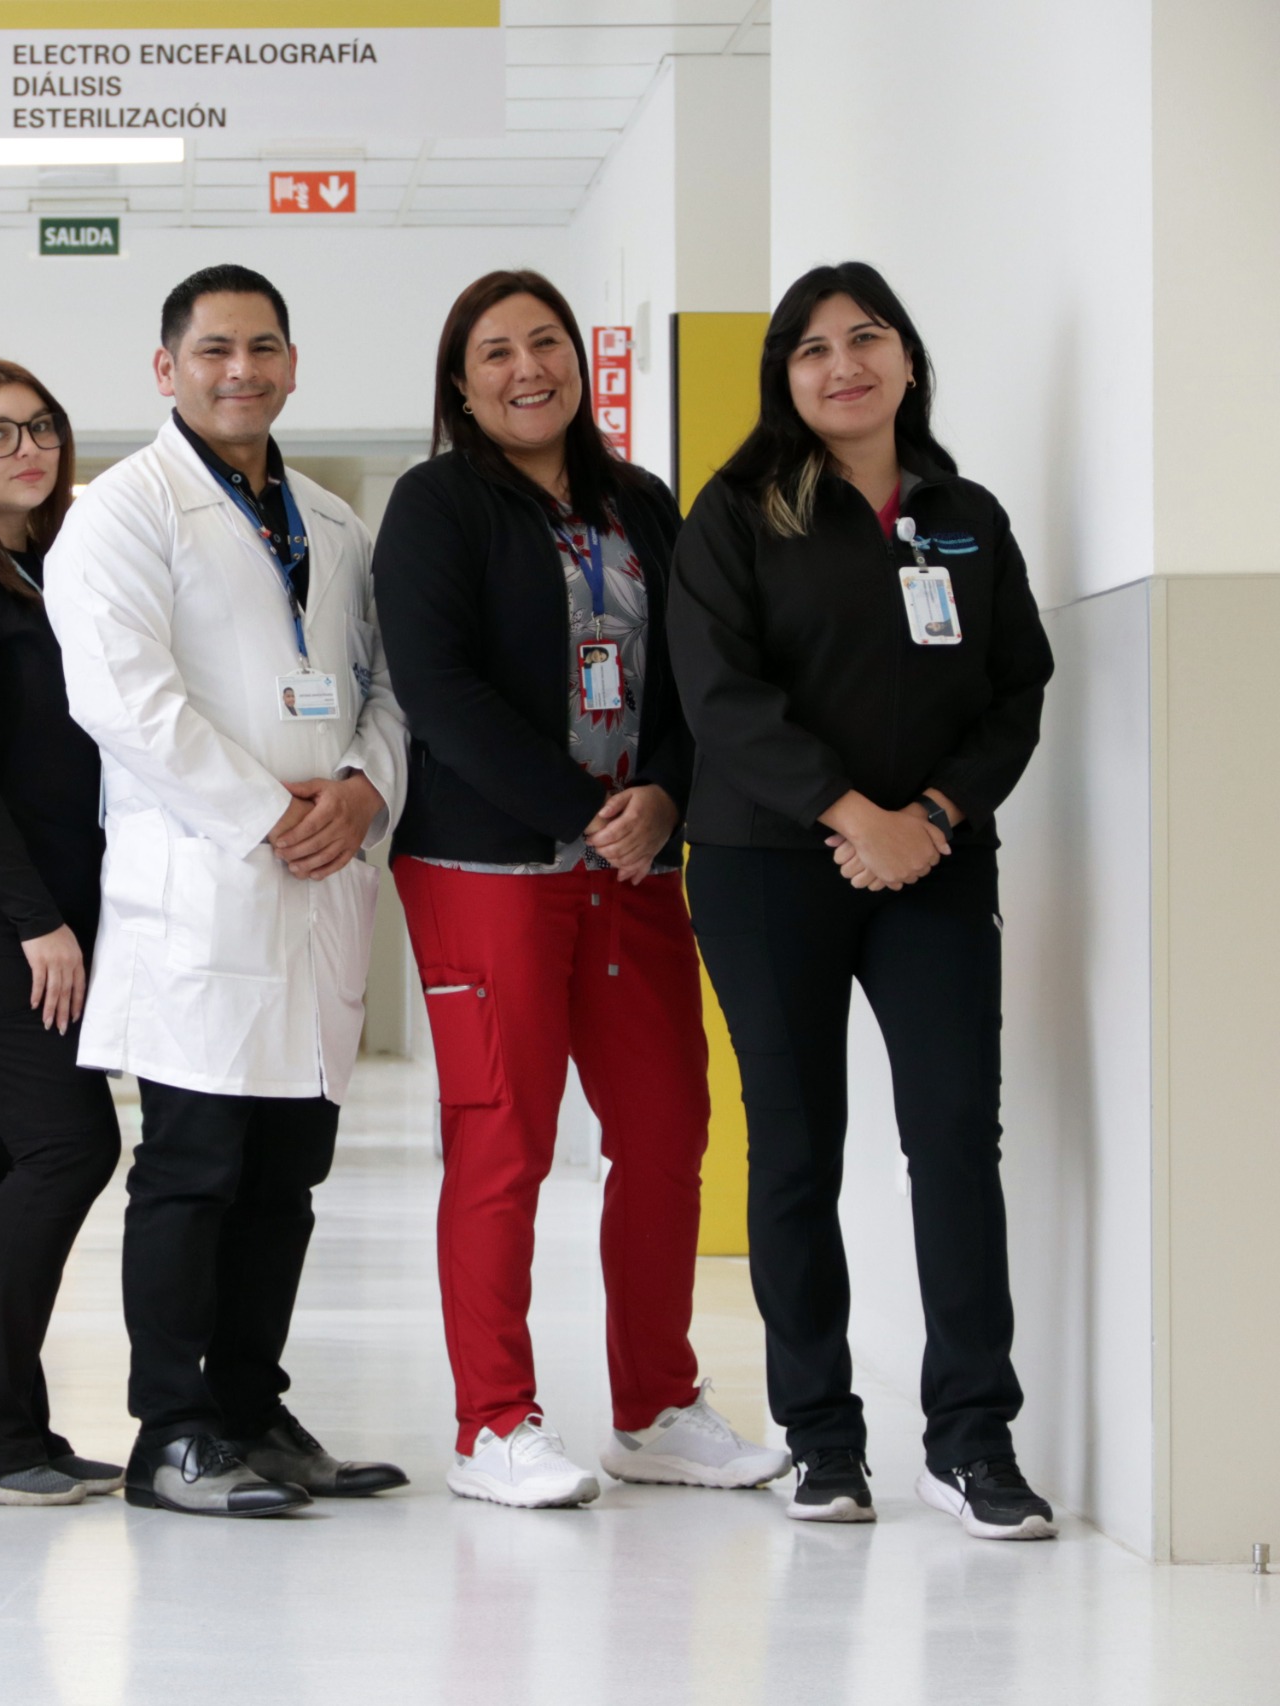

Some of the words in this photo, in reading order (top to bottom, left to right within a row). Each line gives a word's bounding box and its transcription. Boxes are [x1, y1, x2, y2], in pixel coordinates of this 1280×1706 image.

[13, 44, 131, 65] ELECTRO
[140, 38, 377, 64] ENCEFALOGRAFÍA
[13, 71, 122, 97] DIÁLISIS
[13, 102, 227, 128] ESTERILIZACIÓN
[44, 226, 115, 247] SALIDA
